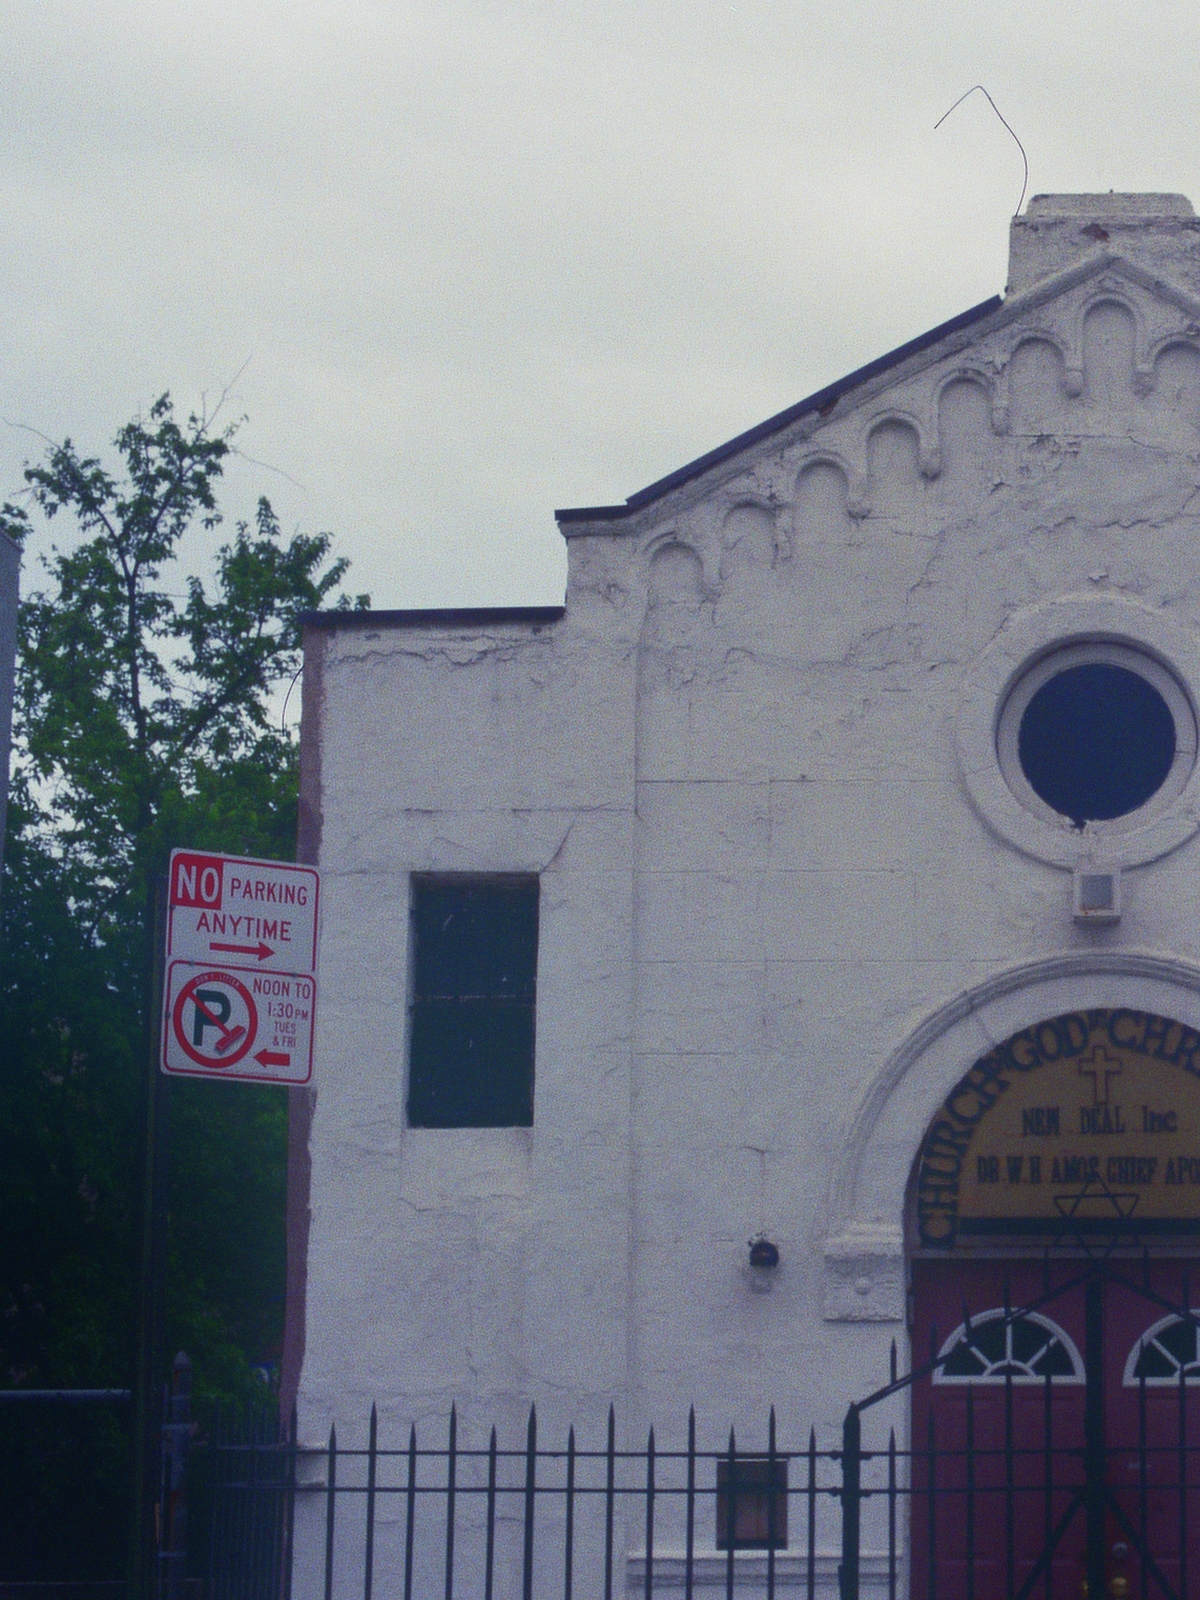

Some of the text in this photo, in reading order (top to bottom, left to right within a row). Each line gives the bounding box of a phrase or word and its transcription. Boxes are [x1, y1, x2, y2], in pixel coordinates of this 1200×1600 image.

[176, 863, 308, 906] NO PARKING
[196, 912, 292, 941] ANYTIME
[253, 978, 311, 999] NOON TO
[272, 1035, 297, 1047] & FRI
[274, 1021, 297, 1035] TUES
[917, 1057, 1011, 1249] CHURCH
[1006, 1012, 1089, 1073] GOD
[1080, 1105, 1126, 1135] DEAL
[1106, 1155, 1159, 1184] CHIEF
